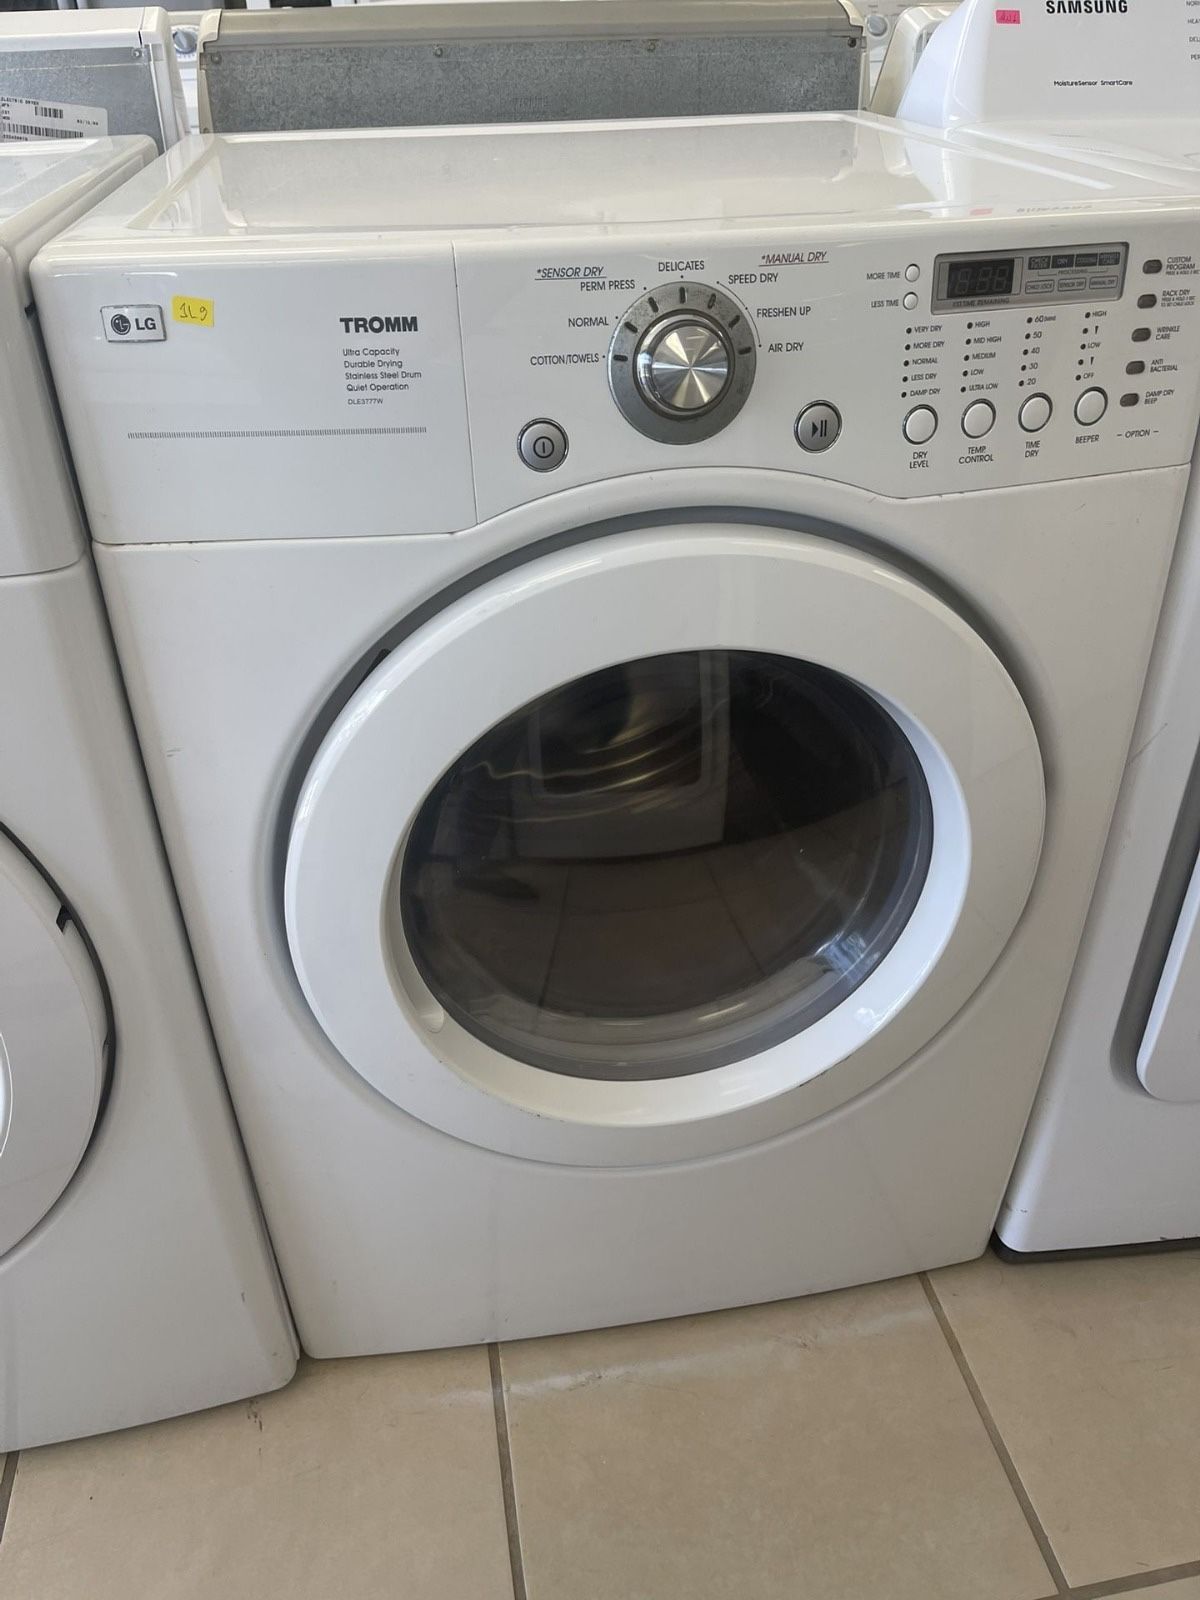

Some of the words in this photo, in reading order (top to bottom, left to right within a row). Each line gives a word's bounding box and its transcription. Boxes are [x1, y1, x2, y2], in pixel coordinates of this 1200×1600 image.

[1046, 0, 1128, 14] SAMSUNG
[807, 251, 827, 262] DRY
[658, 261, 705, 272] DELICATES
[583, 267, 604, 277] DRY
[887, 271, 900, 279] TIME
[728, 275, 757, 284] SPEED
[759, 272, 778, 282] DRY
[580, 281, 606, 291] PERM
[609, 280, 635, 289] PRESS
[886, 299, 899, 307] TIME
[757, 308, 797, 318] FRESHEN
[799, 306, 812, 316] UP
[135, 318, 157, 331] LG
[340, 316, 419, 333] TROMM
[568, 317, 609, 327] NORMAL
[1032, 331, 1042, 339] 50
[362, 347, 400, 357] Capacity
[768, 344, 782, 353] AIR
[785, 343, 804, 352] DRY
[530, 353, 600, 365] COTTON/TOWELS
[972, 352, 996, 360] MEDIUM
[344, 360, 375, 368] Durable
[377, 359, 403, 369] Drying
[1029, 362, 1038, 370] 30
[345, 372, 378, 380] Stainless
[380, 371, 399, 379] Steel
[401, 371, 422, 379] Drum
[346, 383, 367, 391] Quiet
[370, 383, 409, 391] Operation
[1146, 390, 1162, 398] DAMP
[1125, 429, 1151, 438] OPTION
[1075, 435, 1100, 444] BEEPER
[1025, 441, 1041, 449] TIME
[912, 451, 929, 460] DRY
[1024, 450, 1040, 458] DRY
[958, 455, 995, 464] CONTROL
[909, 461, 930, 469] LEVEL
